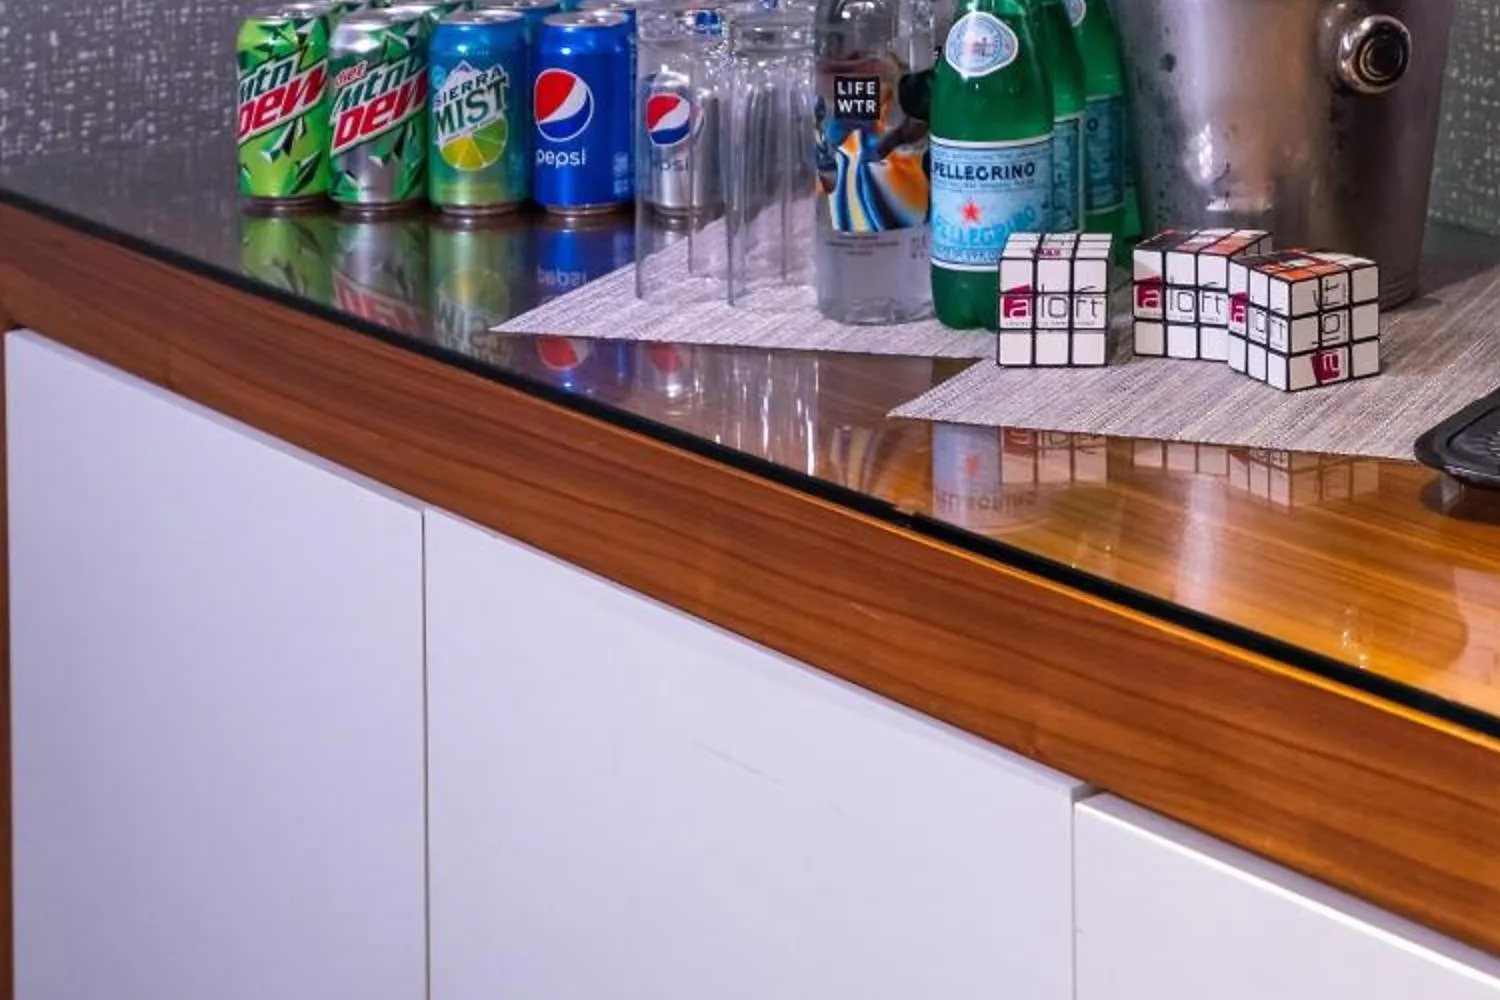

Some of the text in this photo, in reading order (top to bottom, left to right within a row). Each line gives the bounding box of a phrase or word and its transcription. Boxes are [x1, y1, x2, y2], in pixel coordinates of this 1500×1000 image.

[837, 81, 877, 95] LIFE
[434, 77, 506, 132] MIST
[837, 99, 877, 113] WTR
[535, 149, 586, 168] pepsi
[933, 161, 1036, 181] PELLEGRINO
